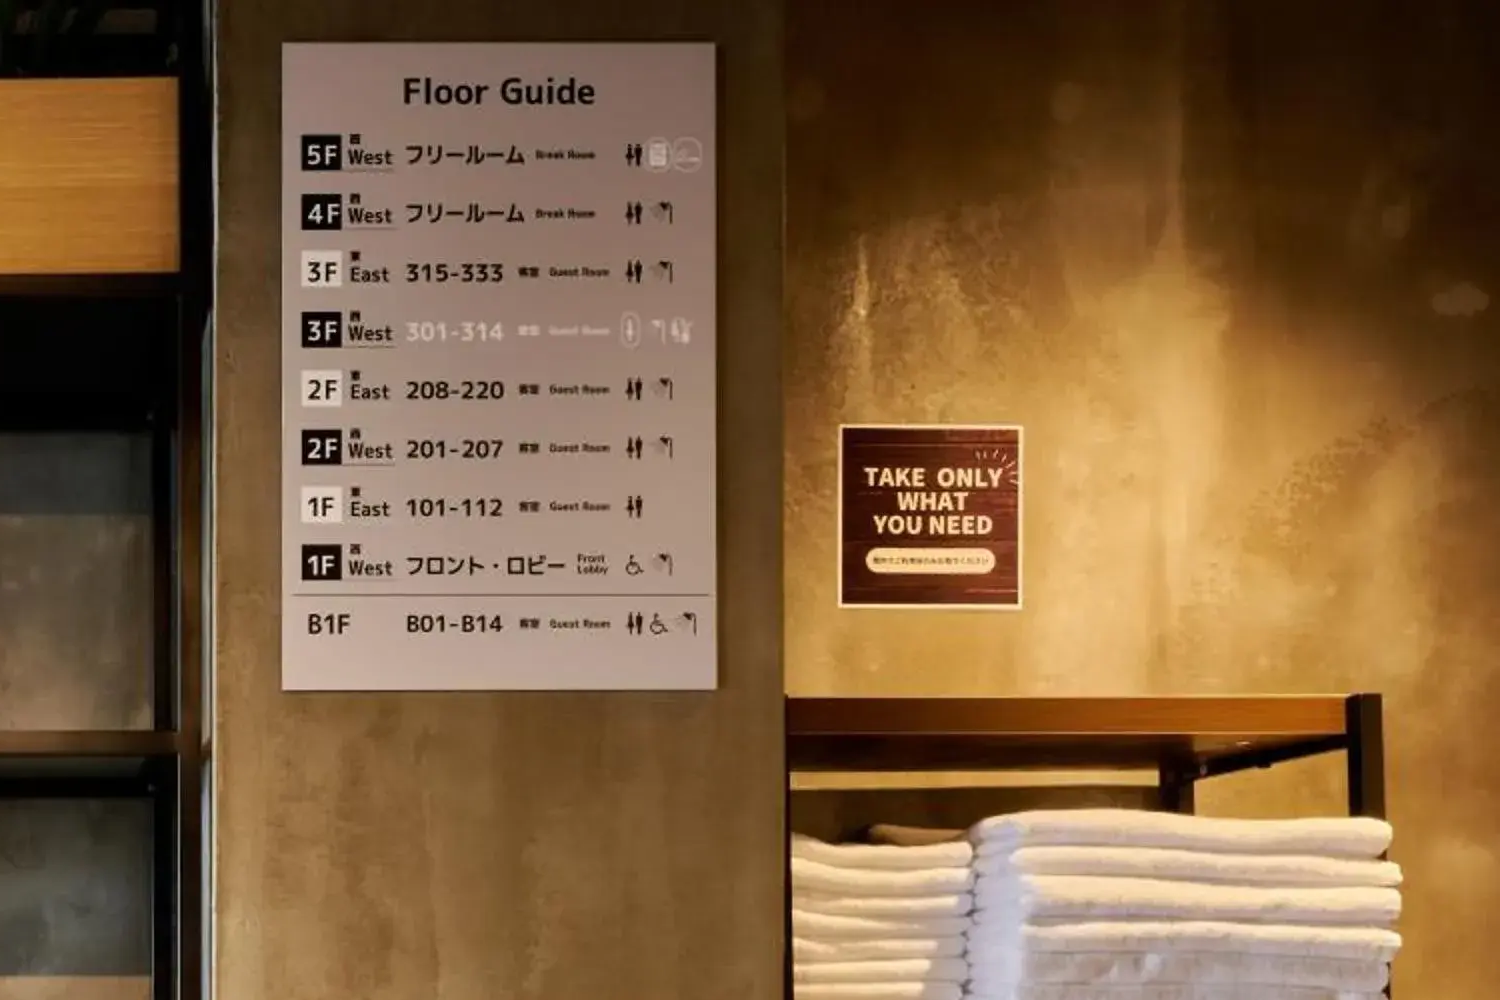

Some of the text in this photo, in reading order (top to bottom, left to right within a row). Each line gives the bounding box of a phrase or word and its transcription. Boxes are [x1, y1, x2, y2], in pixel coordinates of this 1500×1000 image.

[403, 77, 595, 105] Floor Guide
[307, 144, 338, 166] 5F
[347, 148, 393, 166] West
[405, 144, 525, 165] フリールーム
[307, 203, 340, 224] 4F
[347, 207, 392, 224] West
[405, 203, 525, 224] フリールーム
[307, 261, 337, 283] 3F
[349, 266, 389, 283] East
[406, 263, 504, 283] 315-333
[307, 320, 338, 342] 3F
[347, 325, 393, 342] West
[406, 321, 504, 342] 301-314
[307, 379, 338, 401] 2F
[350, 383, 390, 400] East
[406, 380, 505, 400] 208-220
[307, 437, 338, 459] 2F
[347, 442, 393, 459] West
[406, 439, 504, 459] 201-207
[863, 467, 1004, 488] TAKE ONLY
[307, 496, 335, 517] 1F
[350, 501, 390, 517] East
[406, 497, 503, 517] 101-112
[897, 491, 969, 511] WHAT
[873, 515, 993, 535] YOU NEED
[307, 554, 565, 577] 1F West フロント・ロビー
[307, 613, 351, 635] B1F
[406, 614, 504, 633] B01-B14
